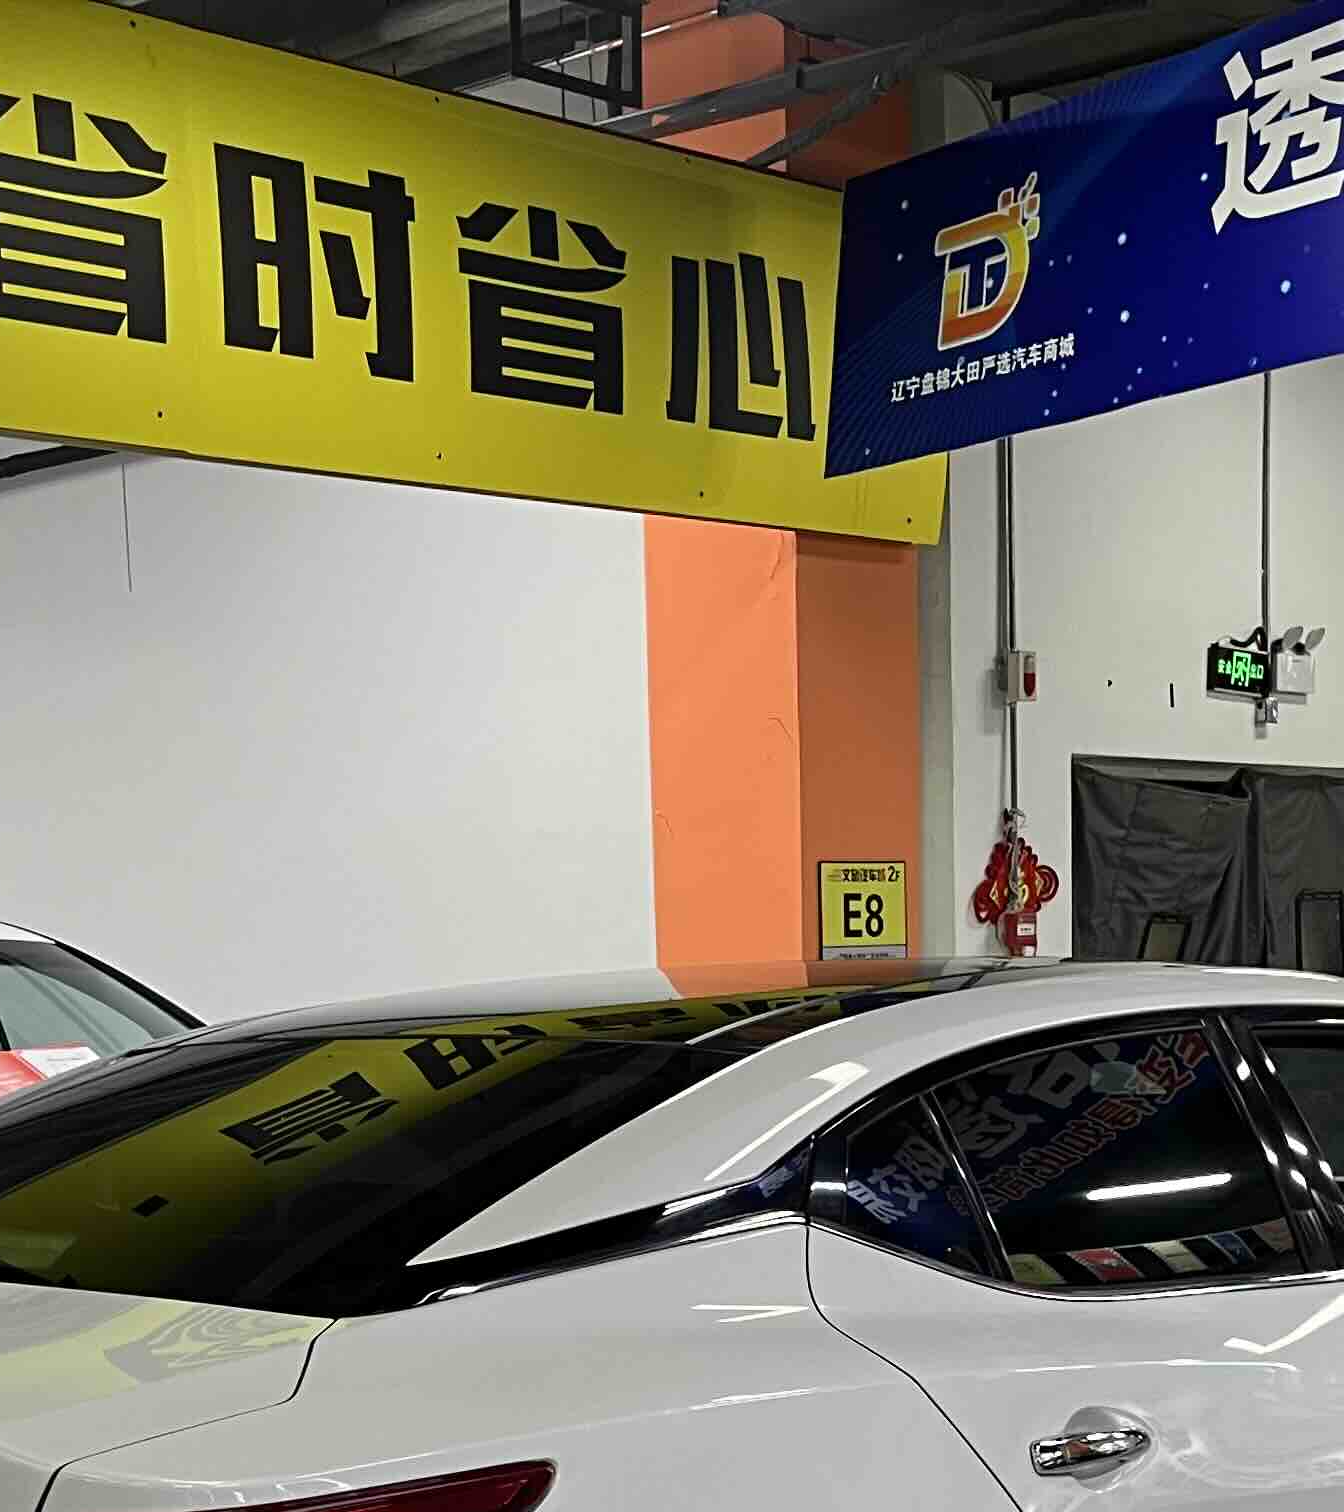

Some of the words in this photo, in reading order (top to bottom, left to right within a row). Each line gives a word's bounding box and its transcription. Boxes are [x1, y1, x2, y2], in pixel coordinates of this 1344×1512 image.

[891, 333, 1075, 403] 辽宁盘锦大田严选汽车商城
[843, 893, 884, 937] E8
